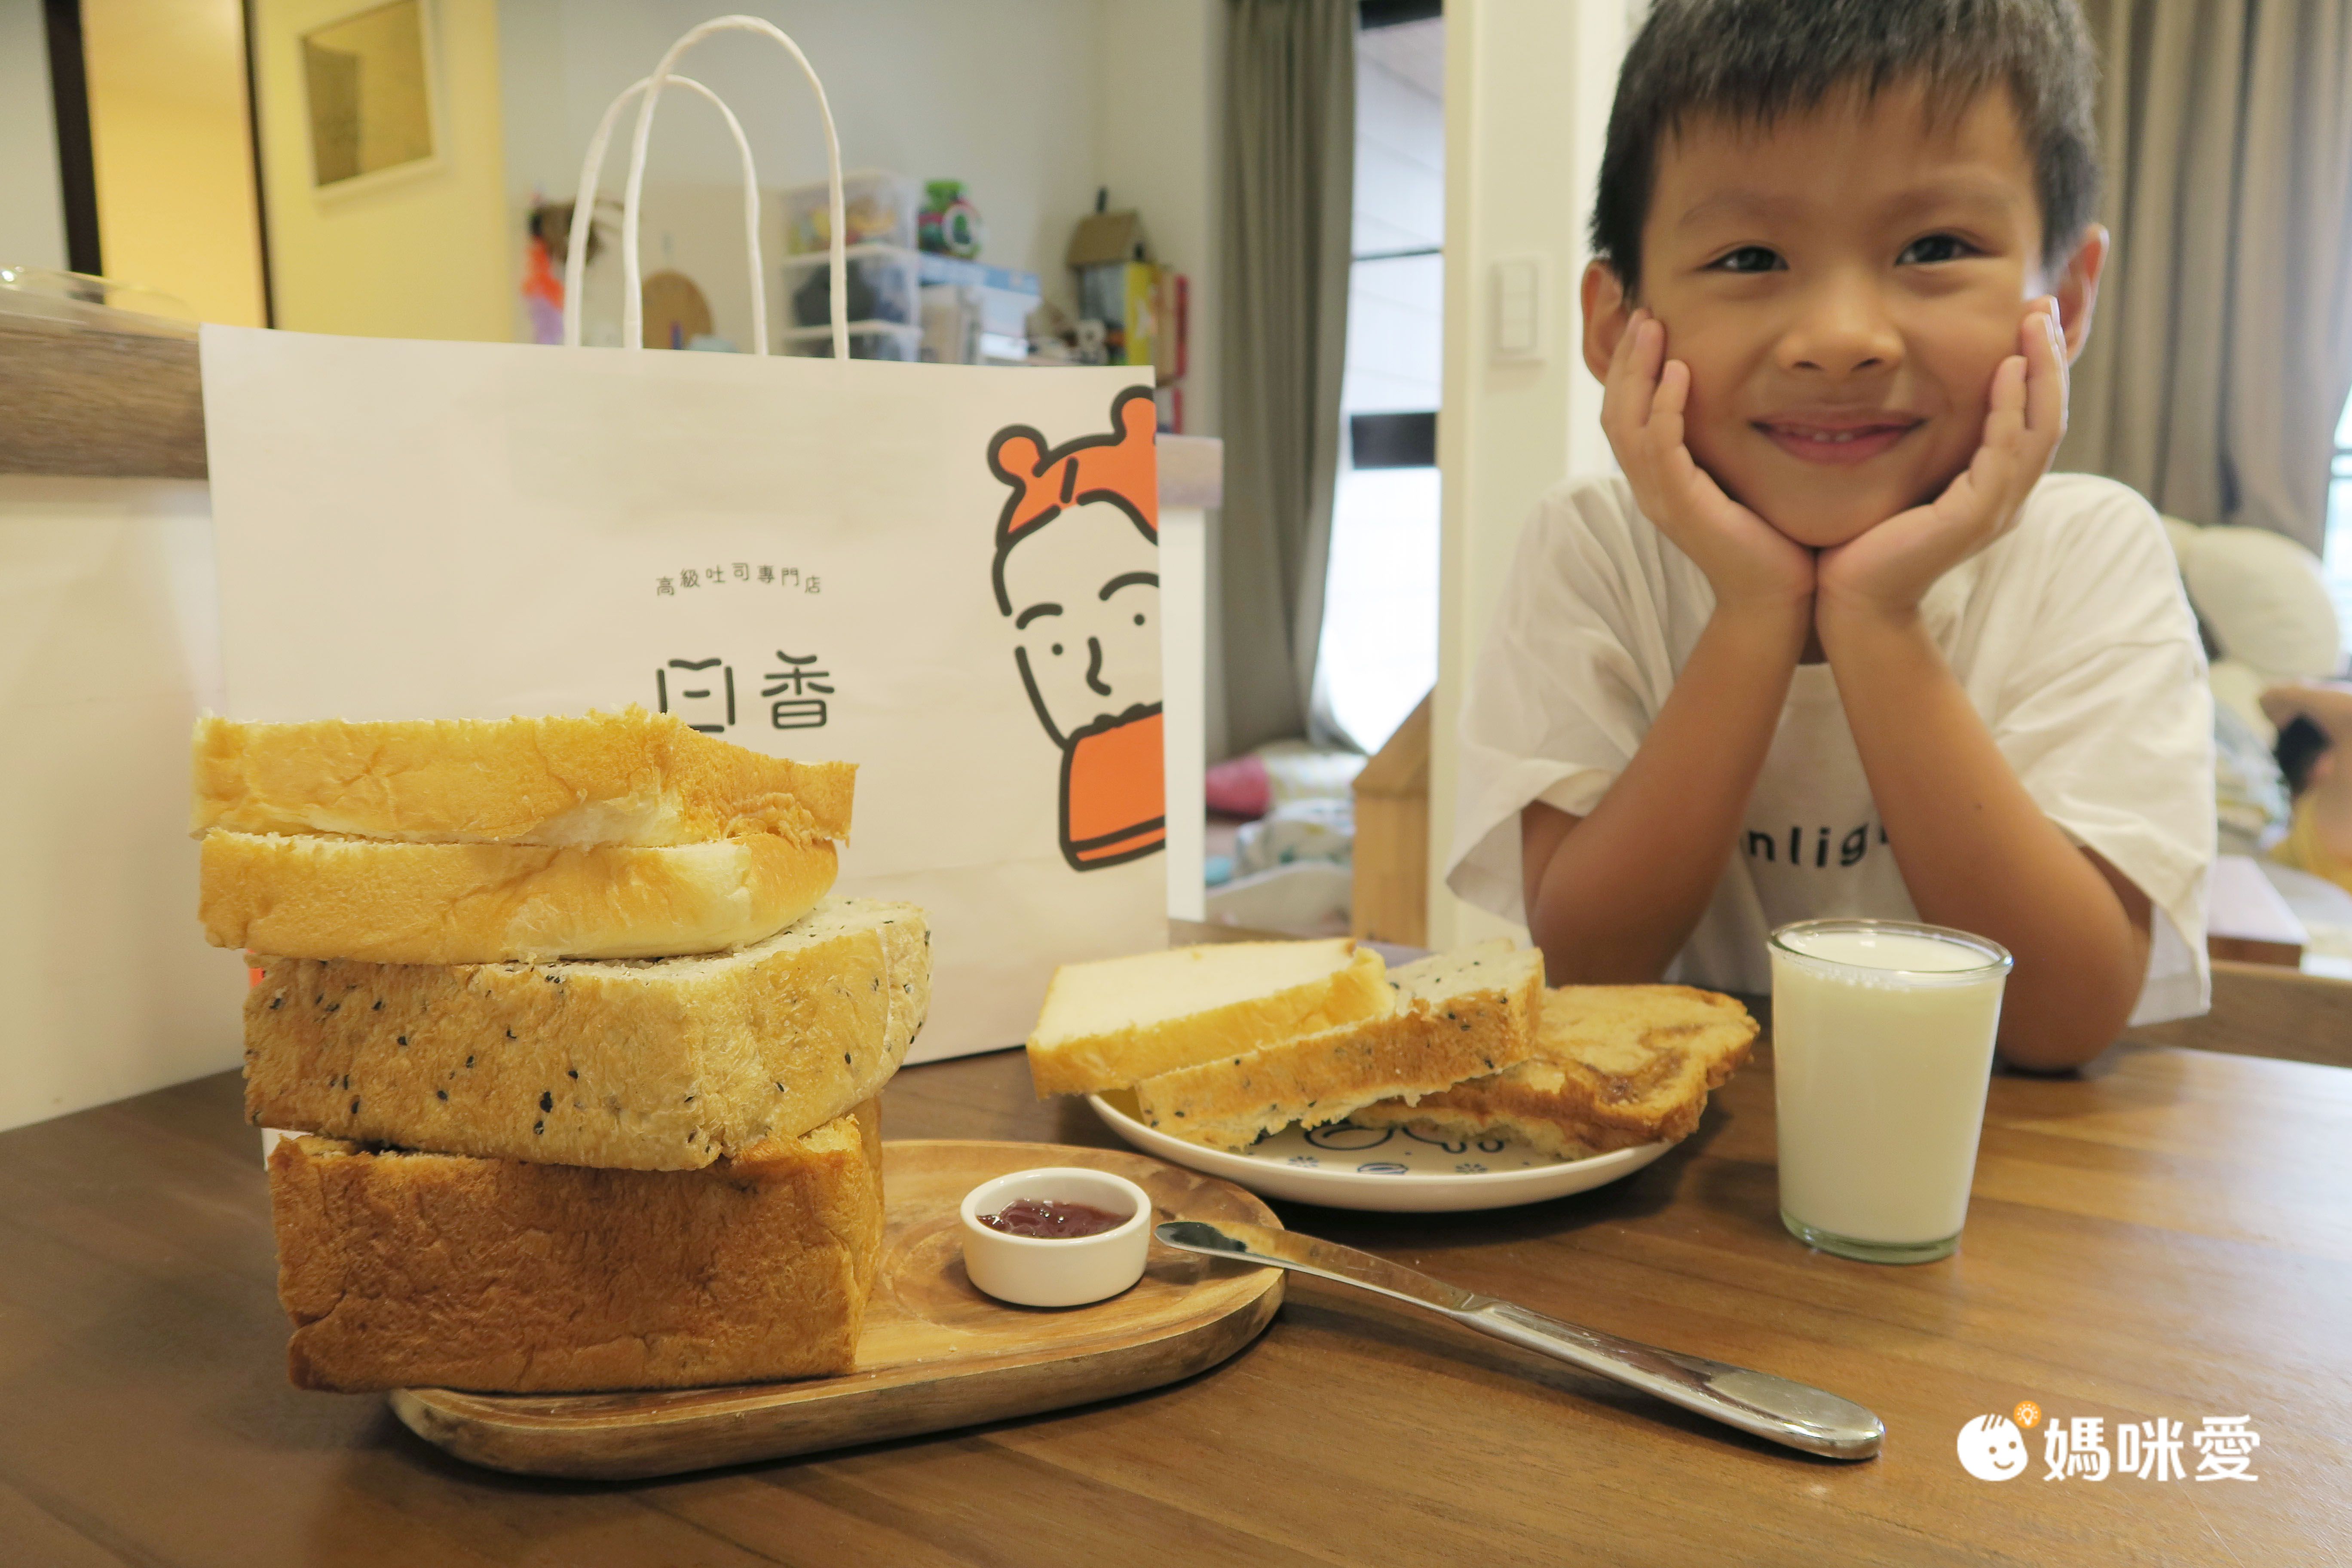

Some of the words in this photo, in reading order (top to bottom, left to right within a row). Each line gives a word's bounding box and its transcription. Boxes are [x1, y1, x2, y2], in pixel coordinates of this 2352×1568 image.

[655, 562, 822, 596] 高級吐司專門店
[1748, 822, 1889, 867] nlig
